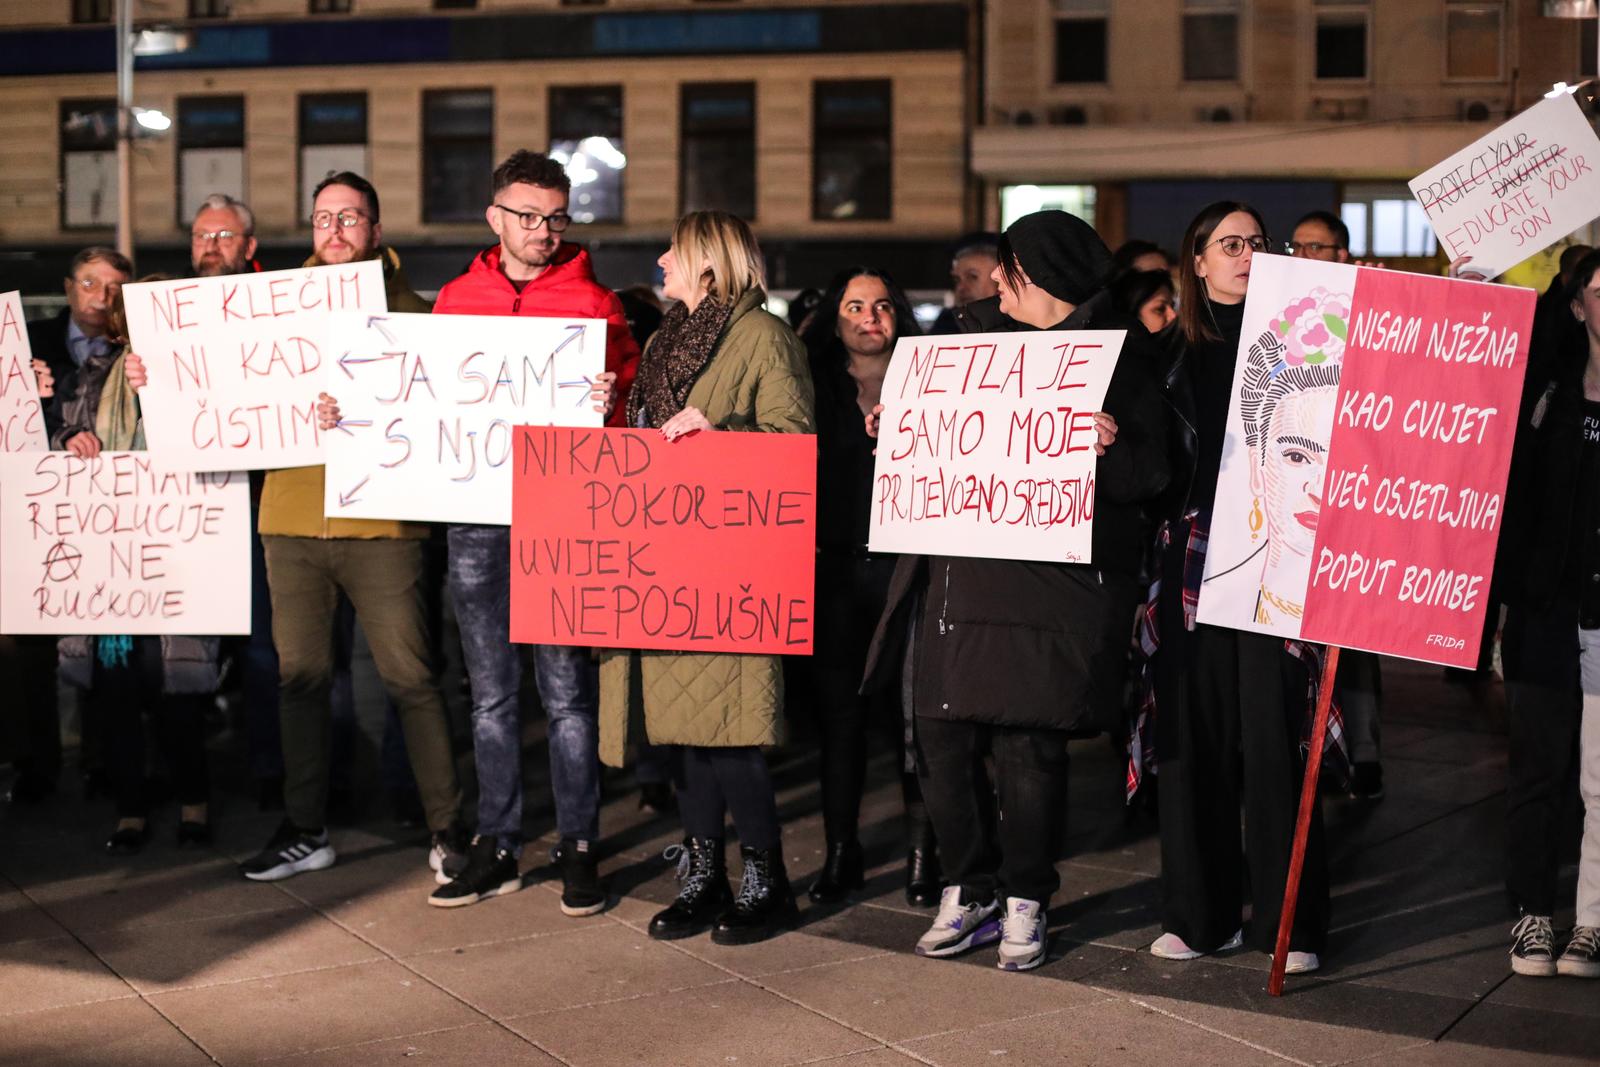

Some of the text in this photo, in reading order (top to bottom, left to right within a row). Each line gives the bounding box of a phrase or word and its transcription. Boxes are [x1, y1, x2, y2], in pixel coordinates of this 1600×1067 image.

[1416, 132, 1535, 220] PROTECT YOUR
[1445, 155, 1592, 257] EDUCATE YOUR
[1510, 206, 1553, 247] SON
[149, 271, 361, 332] NE KLEČIM
[173, 336, 321, 391] NI KAD
[1350, 307, 1519, 369] NISAM NJEŽNA
[0, 354, 29, 397] A
[375, 351, 556, 408] JA SAM
[900, 343, 1103, 399] METLA JE
[191, 397, 321, 450] ČISTIM
[379, 417, 411, 469] S
[891, 406, 1094, 465] SAMO MOJE
[1338, 390, 1497, 445] KAO CVIJET
[522, 431, 651, 478] NIKAD
[27, 502, 225, 543] REVOLUCIJE
[583, 481, 812, 530] POKORENE
[1005, 470, 1095, 530] SREDSTVO
[1327, 464, 1500, 532] VEĆ OSJETLJIVA
[109, 540, 174, 581] NE
[519, 539, 656, 577] UVIJEK
[1313, 545, 1484, 613] POPUT BOMBE
[32, 581, 185, 620] RUČKOVE
[551, 583, 809, 645] NEPOSLUŠNE
[1426, 633, 1466, 651] FRIDA
